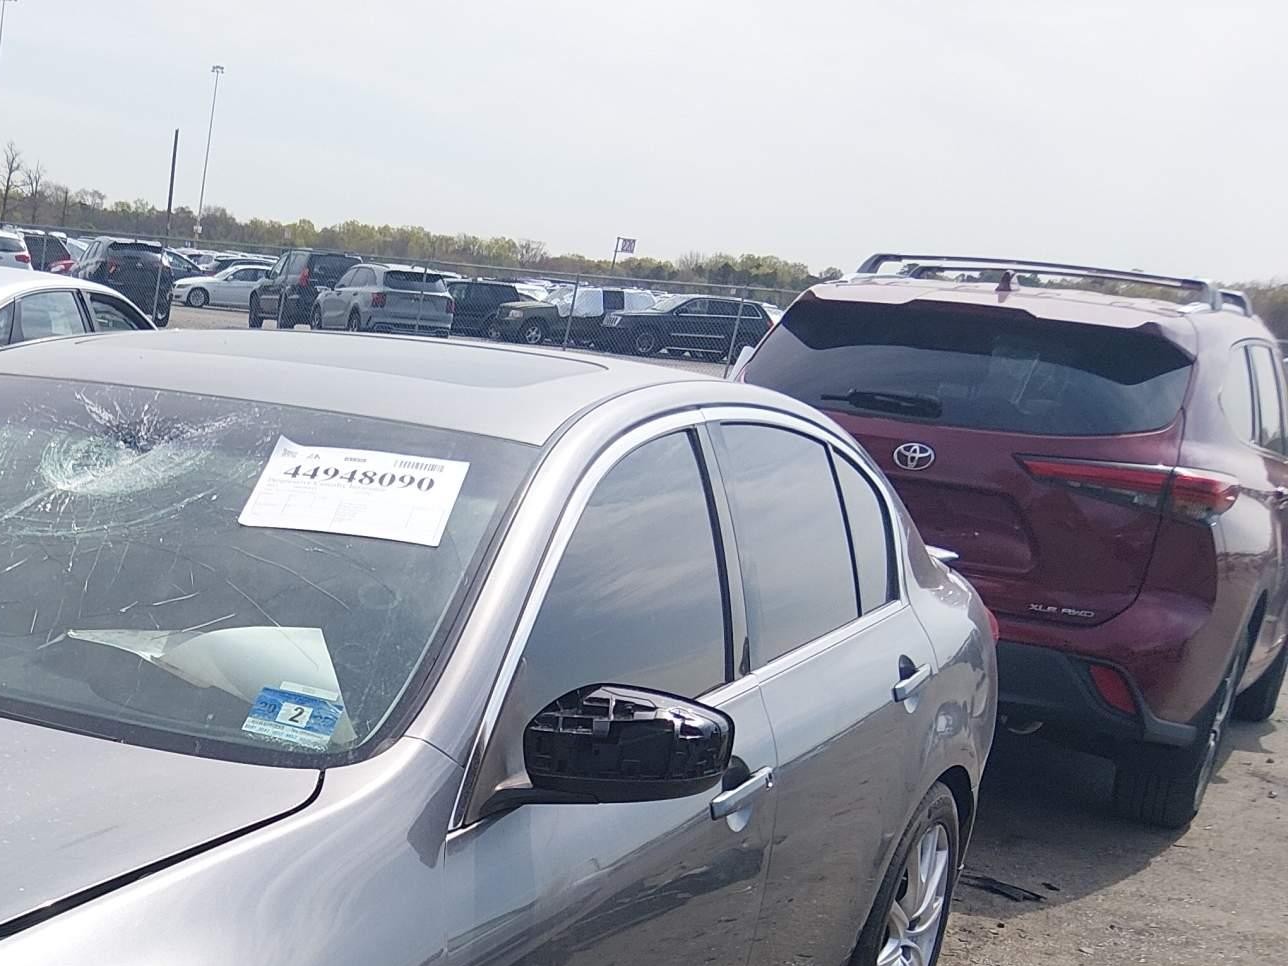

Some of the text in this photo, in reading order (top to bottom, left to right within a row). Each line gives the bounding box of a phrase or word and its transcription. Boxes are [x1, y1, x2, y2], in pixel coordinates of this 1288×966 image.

[283, 464, 435, 492] 44948090
[1029, 603, 1095, 618] XLE AWD
[288, 706, 305, 723] 2
